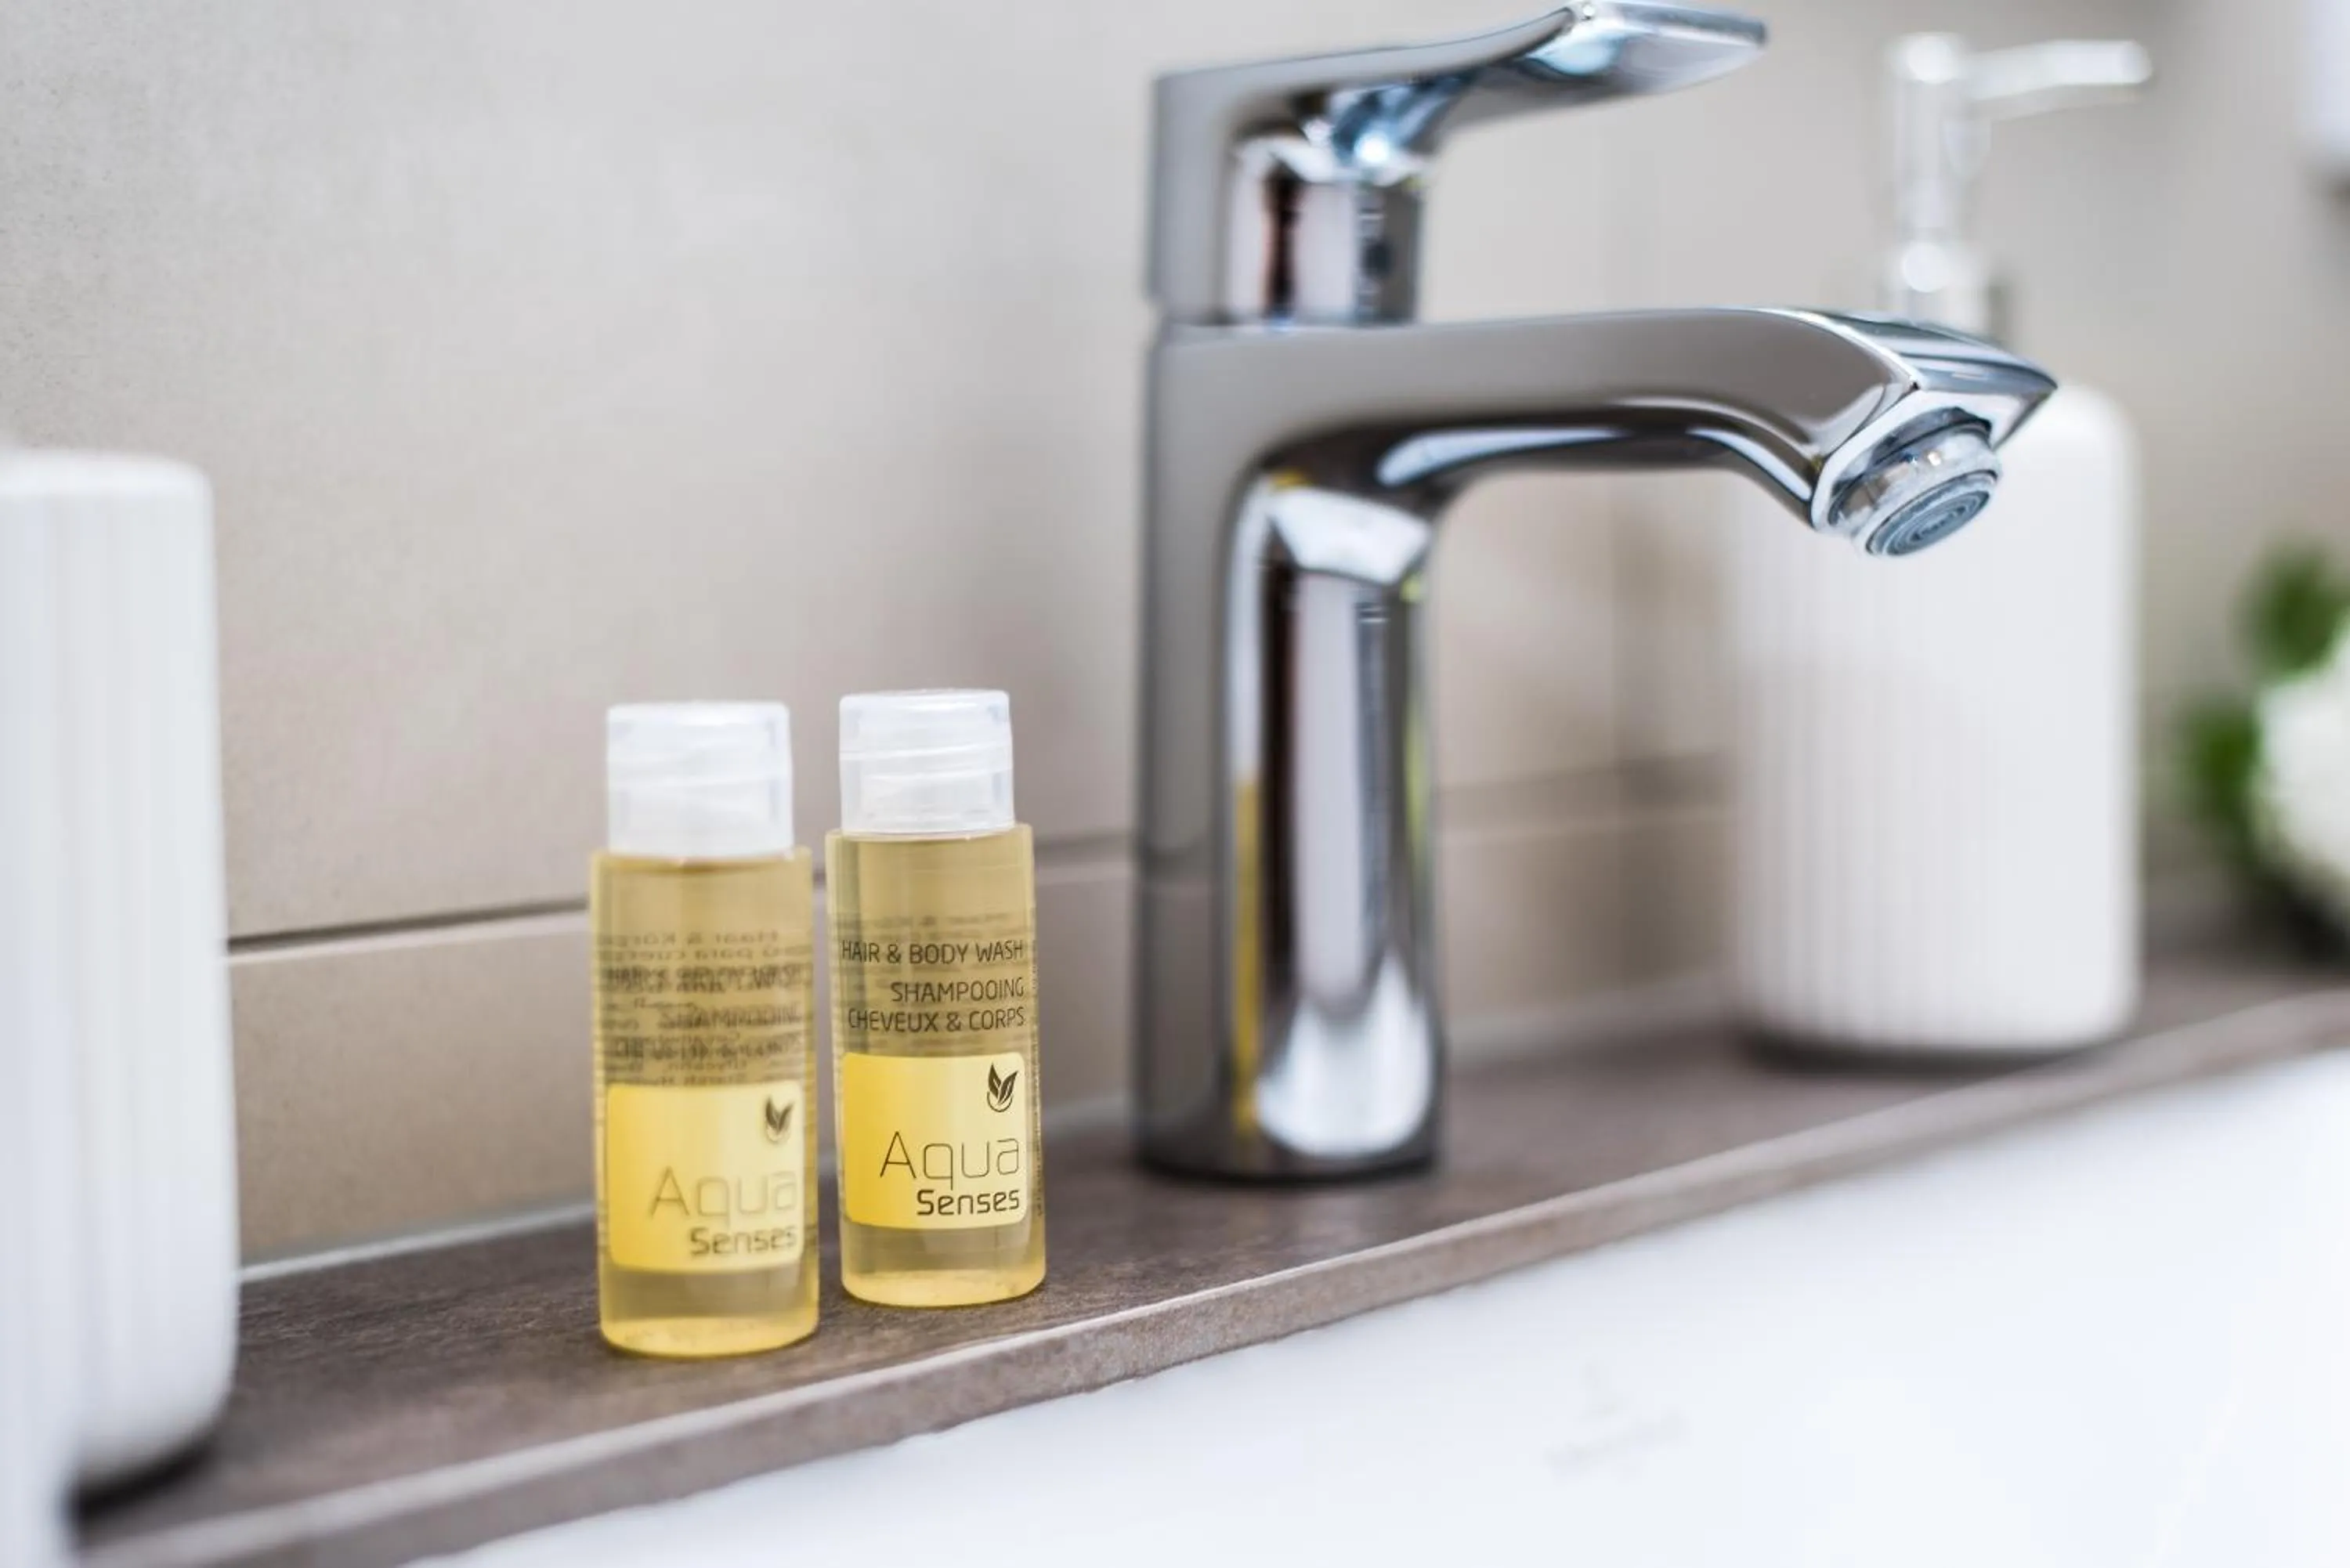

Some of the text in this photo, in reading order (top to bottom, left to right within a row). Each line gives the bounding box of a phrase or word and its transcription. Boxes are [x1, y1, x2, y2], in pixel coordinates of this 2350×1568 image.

[842, 940, 1024, 965] HAIR & BODY WASH
[891, 977, 1025, 1003] SHAMPOOING
[848, 1006, 1025, 1033] CHEVEUX & CORPS
[880, 1131, 1020, 1190] Aqua
[649, 1165, 798, 1230] Aqua
[916, 1189, 1020, 1216] Senses
[689, 1225, 798, 1258] Senses
